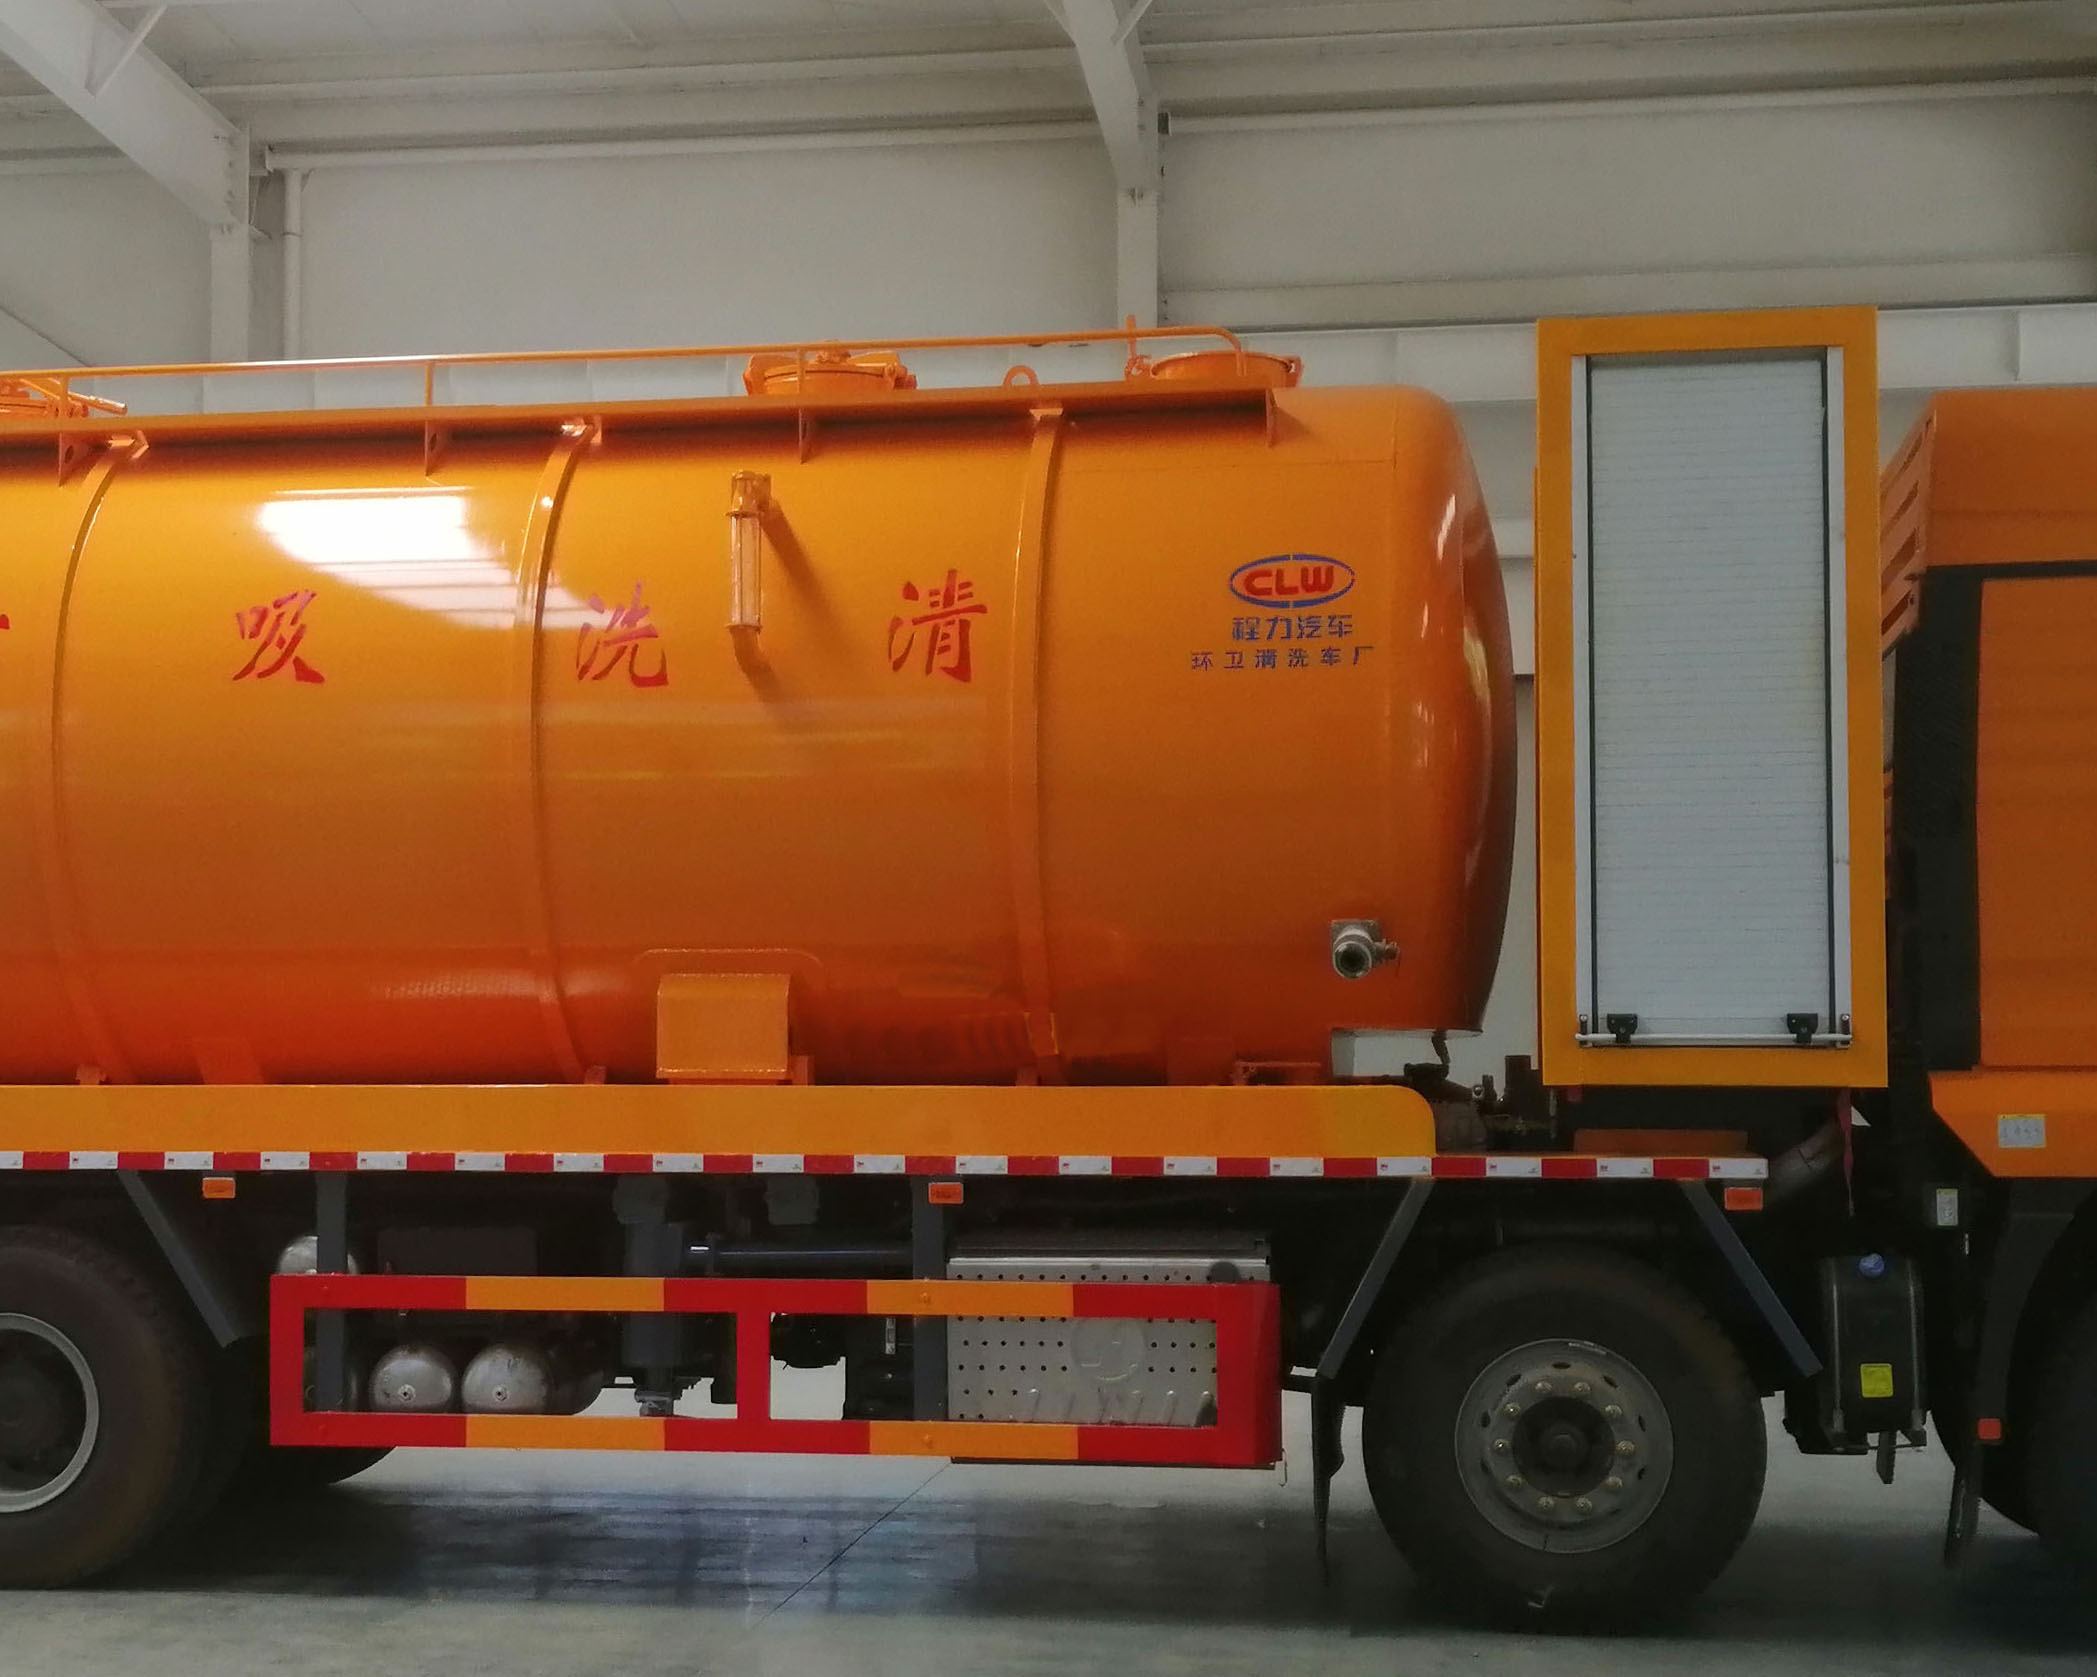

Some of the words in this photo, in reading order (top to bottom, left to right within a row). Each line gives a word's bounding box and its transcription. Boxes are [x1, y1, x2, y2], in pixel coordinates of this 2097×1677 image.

[1243, 566, 1334, 597] CLW
[233, 590, 325, 684] 吸
[577, 582, 668, 687] 洗
[889, 569, 988, 683] 清
[1232, 615, 1353, 641] 程力汽车
